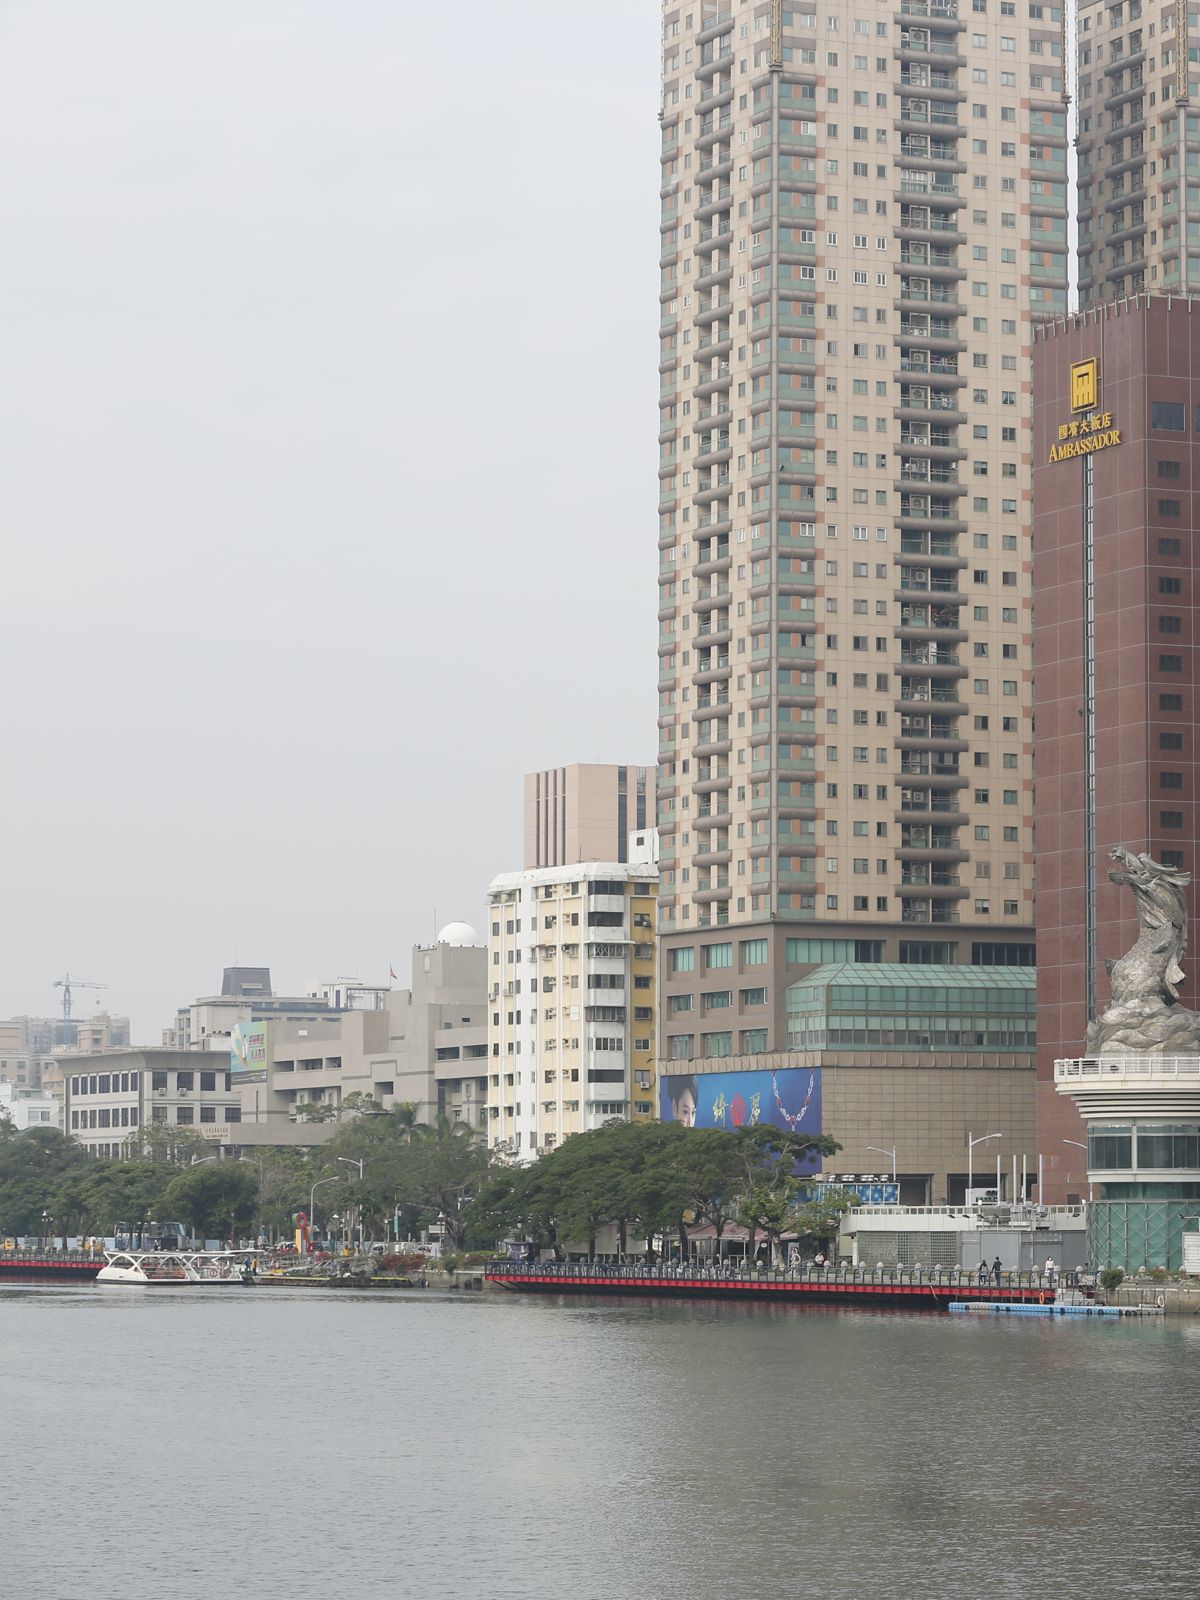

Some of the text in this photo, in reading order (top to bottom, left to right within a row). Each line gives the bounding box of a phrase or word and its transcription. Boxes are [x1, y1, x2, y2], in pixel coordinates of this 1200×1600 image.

[1058, 412, 1112, 440] 國賓大飯店
[1048, 430, 1121, 462] AMBASSADOR
